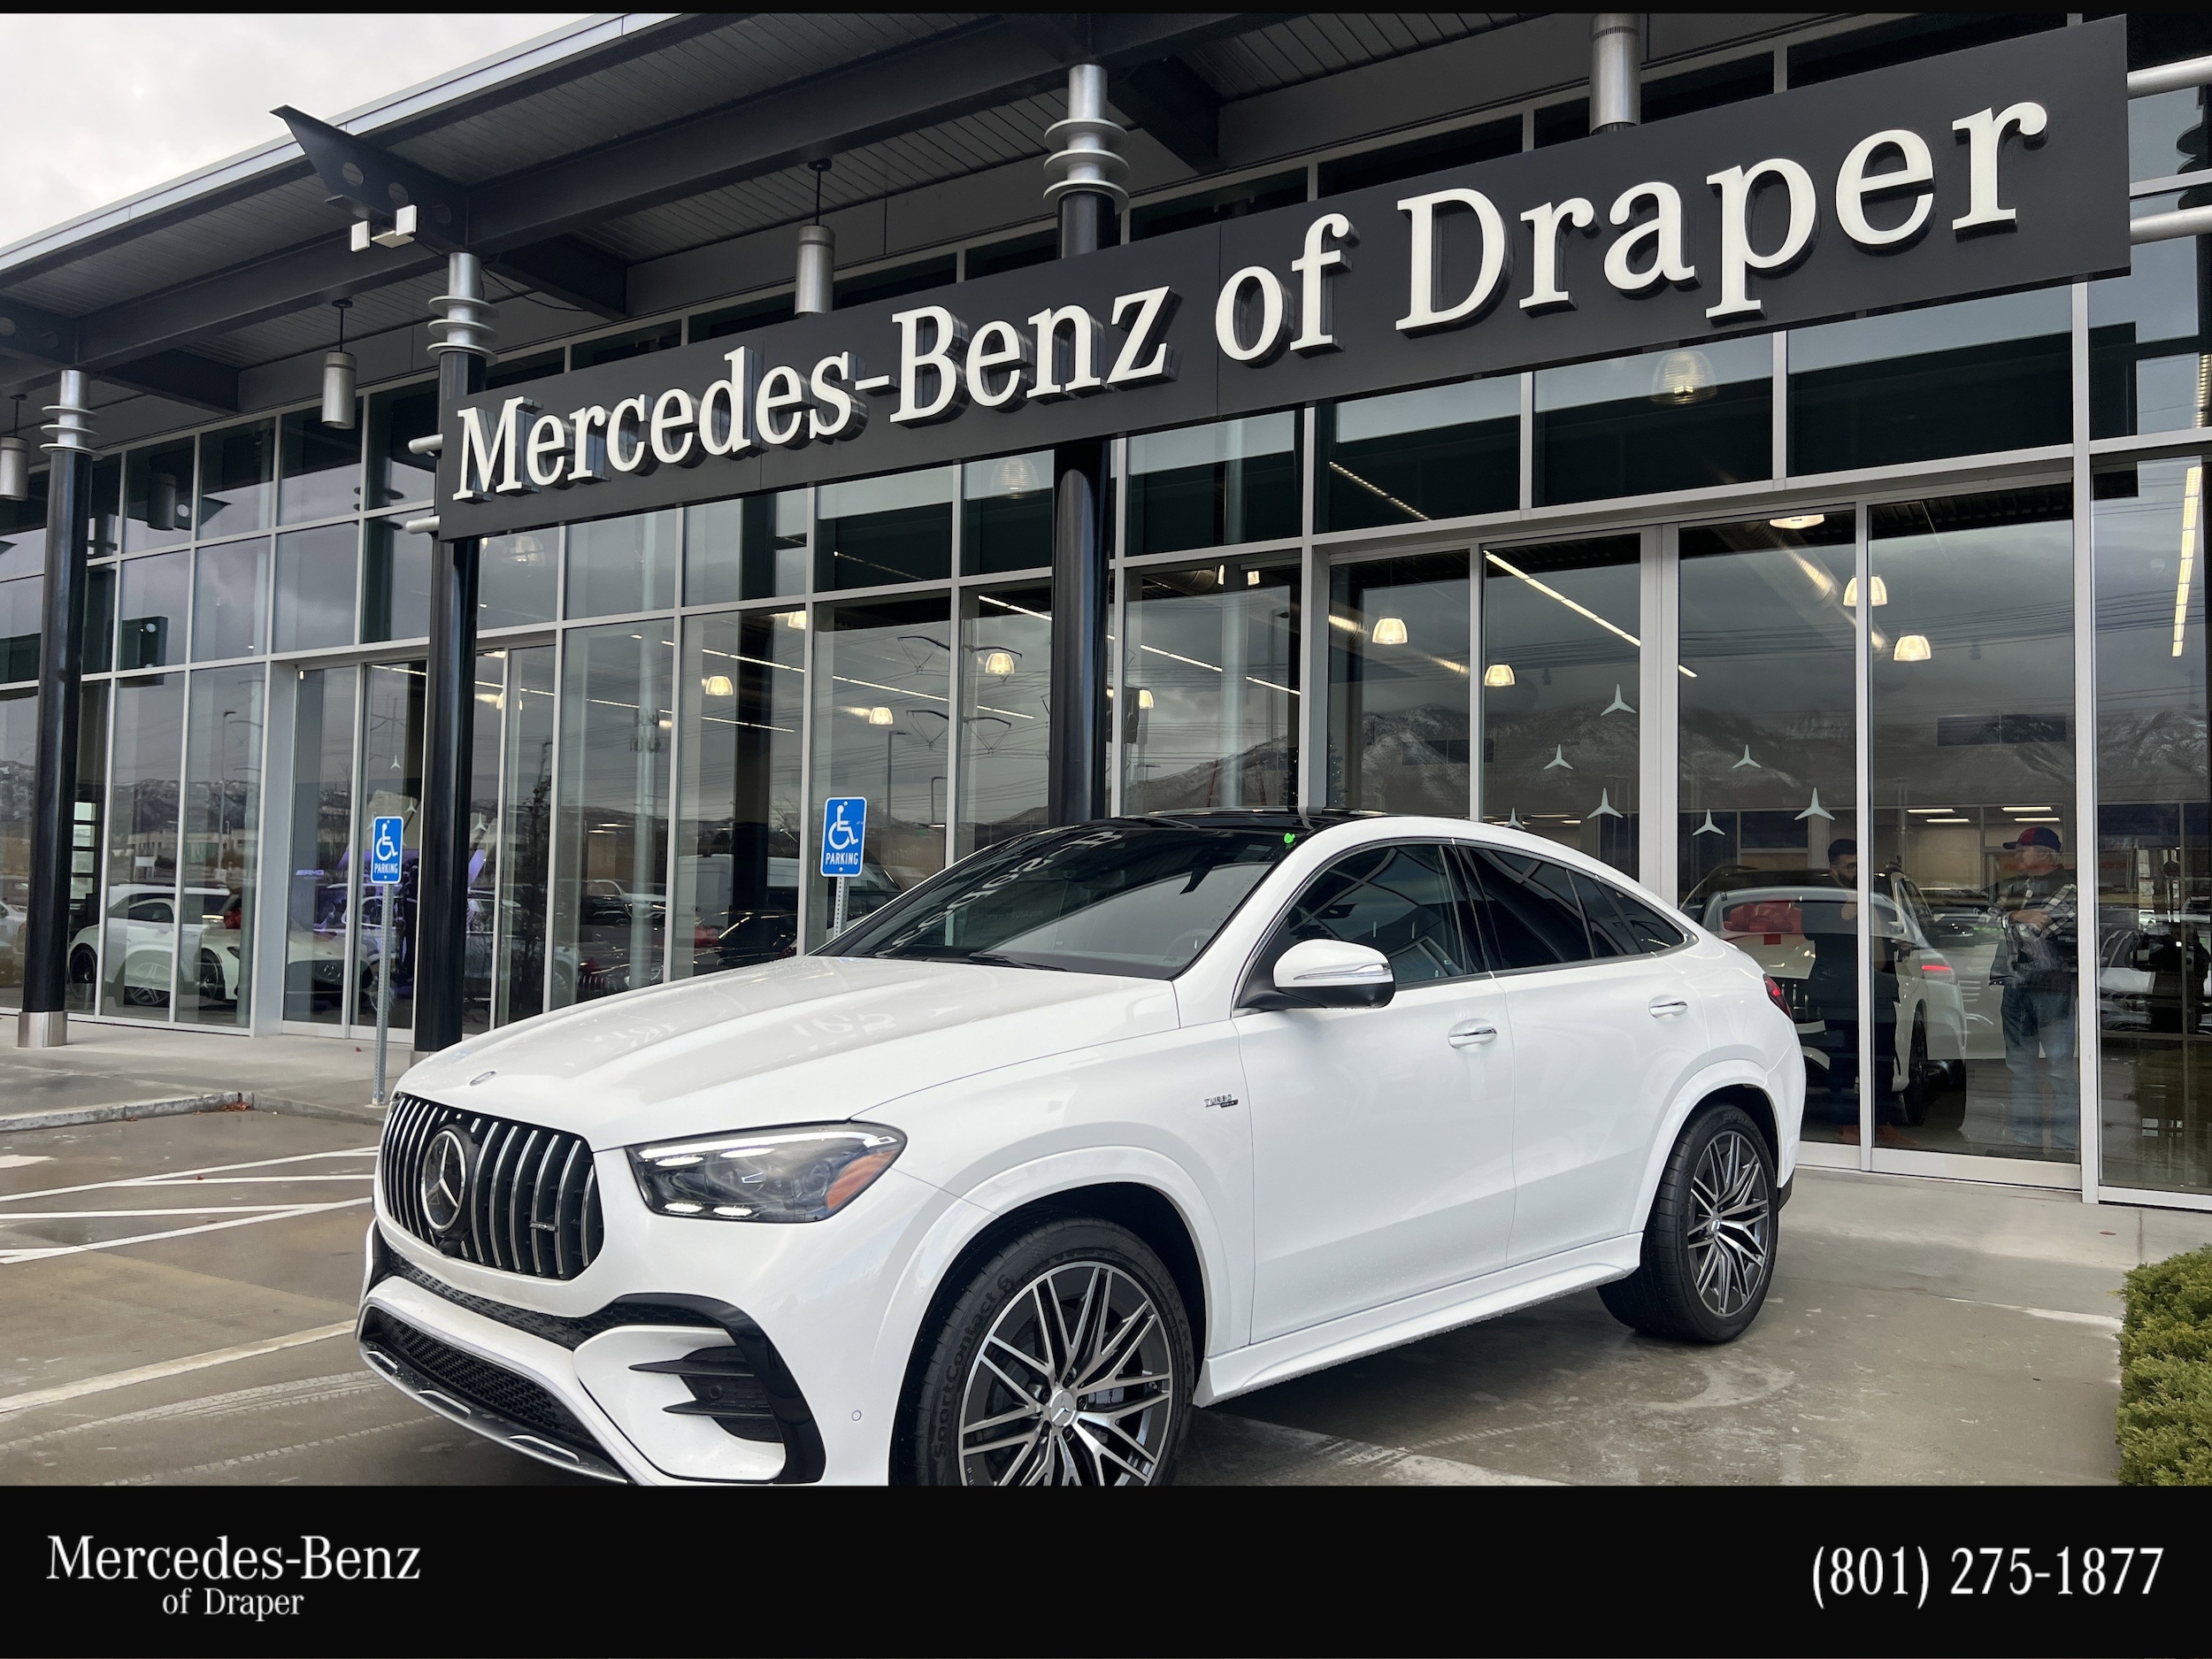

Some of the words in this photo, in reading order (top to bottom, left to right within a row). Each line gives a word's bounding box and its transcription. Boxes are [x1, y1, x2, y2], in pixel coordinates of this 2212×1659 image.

[452, 285, 1171, 502] Mercedes-Benz
[1215, 212, 1351, 361] of
[1395, 101, 2048, 331] Draper
[825, 852, 859, 865] PARKING
[373, 863, 398, 874] PARKING
